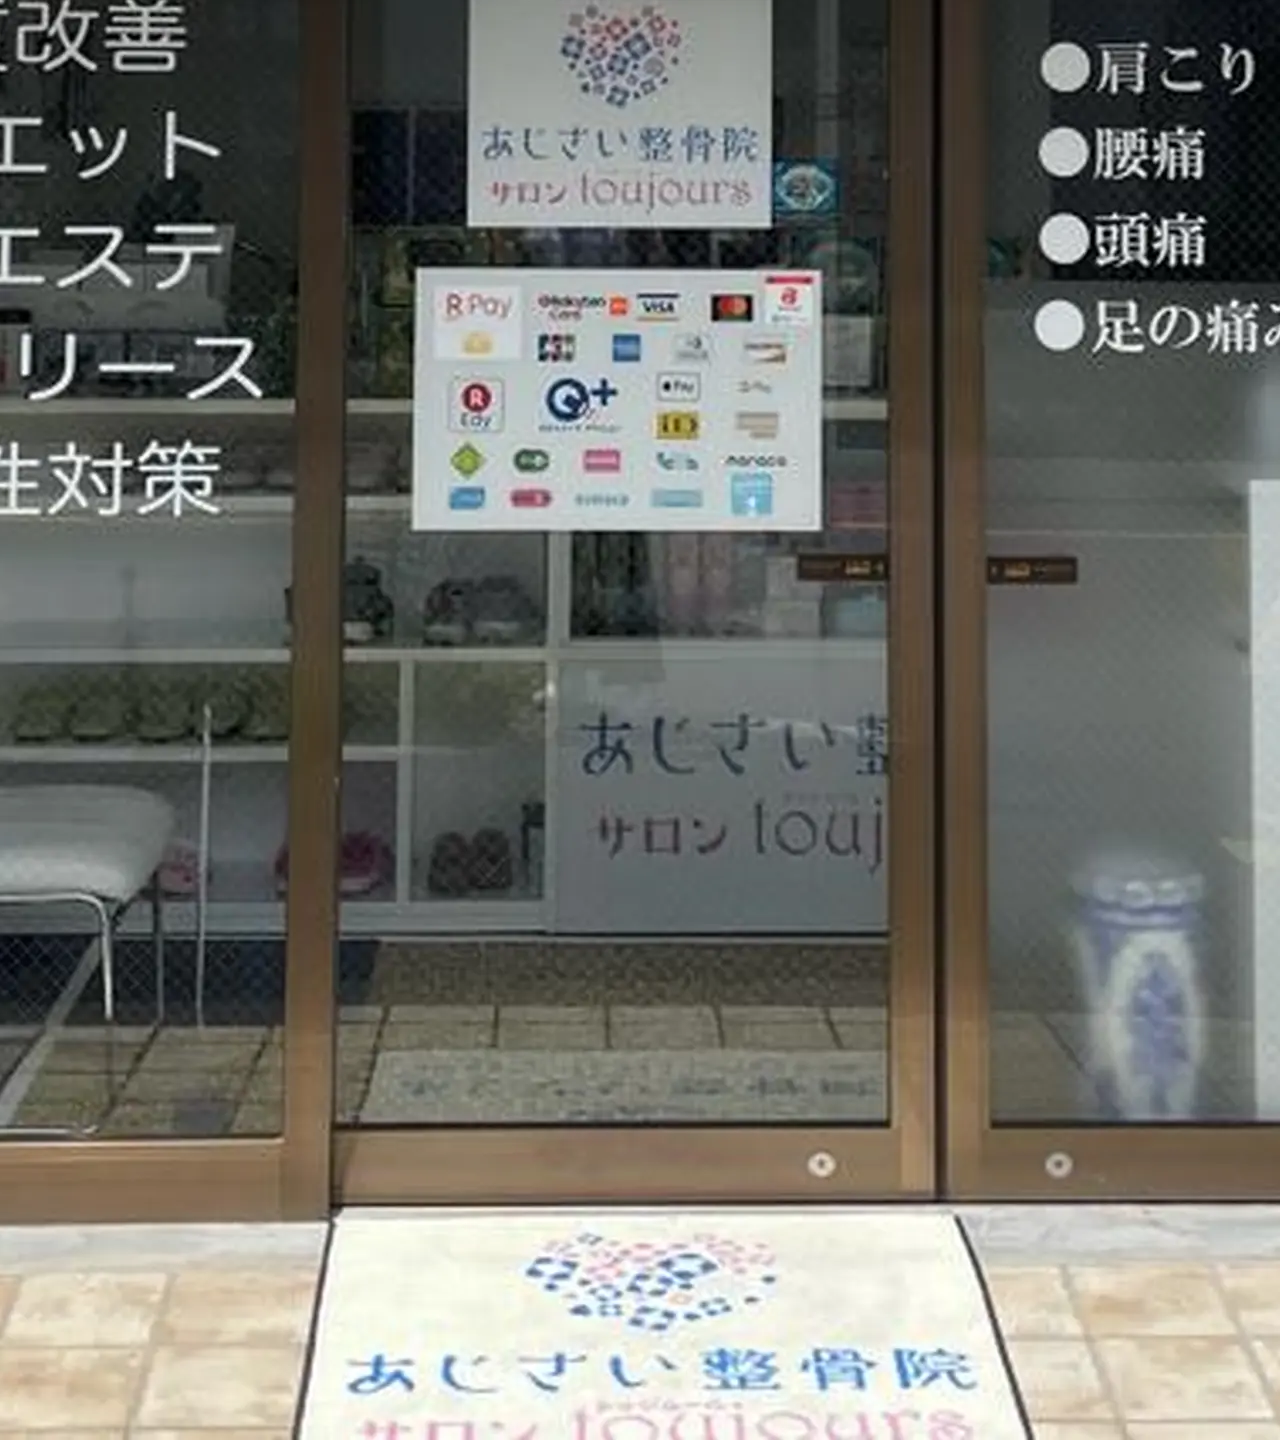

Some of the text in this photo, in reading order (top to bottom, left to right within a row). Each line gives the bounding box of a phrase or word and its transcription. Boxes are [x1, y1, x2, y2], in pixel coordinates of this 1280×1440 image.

[1095, 41, 1257, 95] 肩こり
[481, 125, 759, 163] あじさい整骨院
[1093, 126, 1207, 182] 腰痛
[487, 170, 753, 214] サロン toujours
[1093, 212, 1208, 267] 頭痛
[642, 301, 675, 313] VISA
[590, 816, 728, 860] サロン
[346, 1348, 978, 1394] あじさい整骨院
